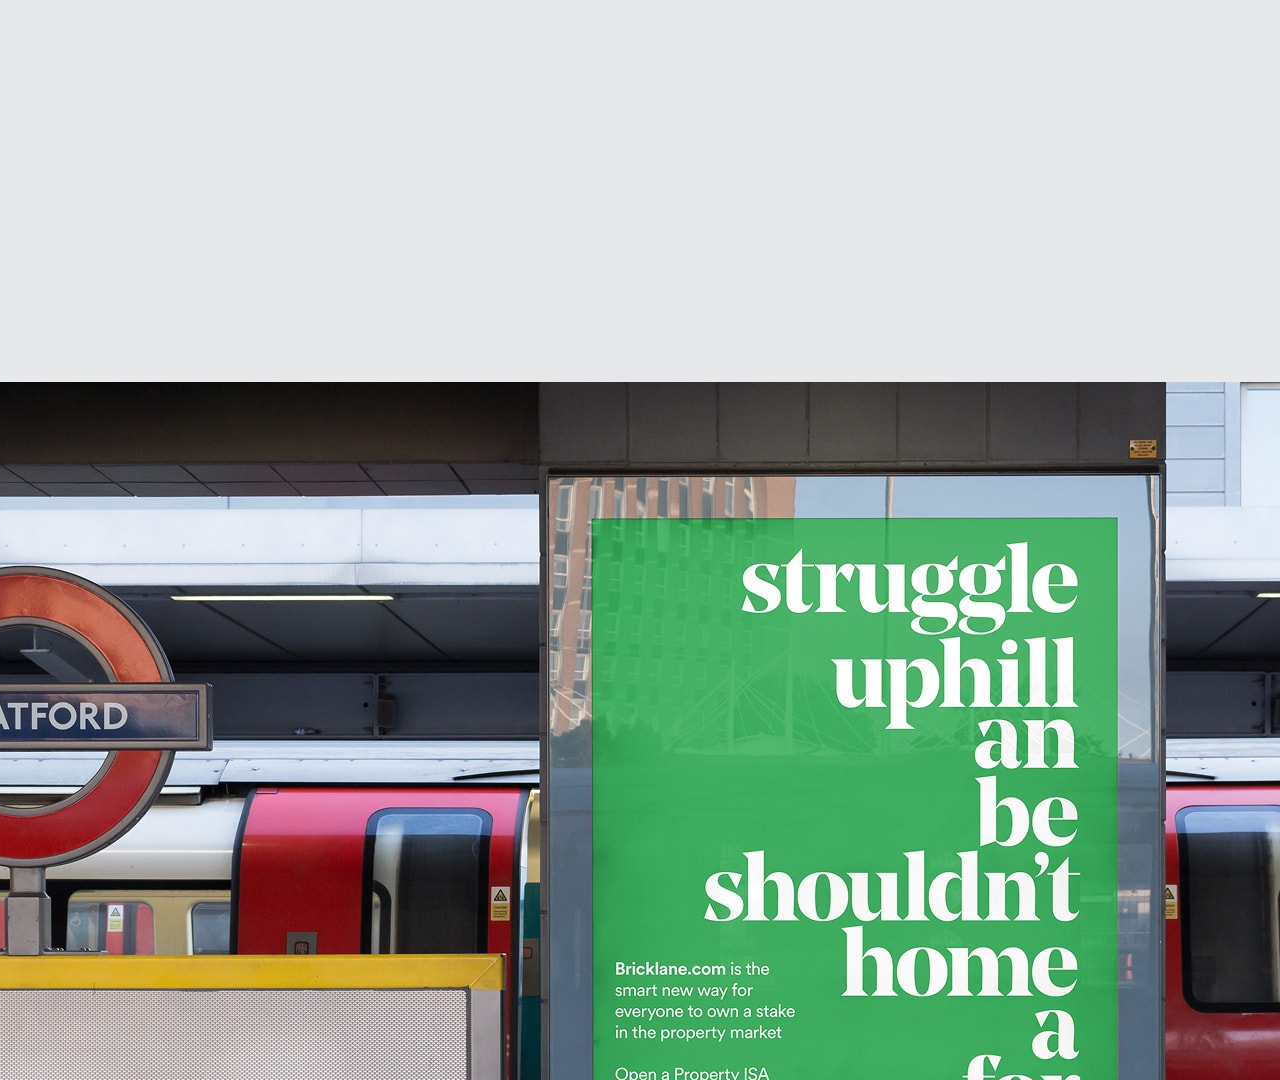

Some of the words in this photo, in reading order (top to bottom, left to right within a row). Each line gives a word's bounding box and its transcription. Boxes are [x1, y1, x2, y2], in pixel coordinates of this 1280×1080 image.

[742, 542, 1077, 635] struggle
[832, 637, 1078, 729] uphill
[975, 720, 1079, 769] an
[976, 776, 1077, 846] be
[704, 851, 1080, 921] shouldn't
[615, 961, 726, 976] Bricklane.com
[730, 961, 742, 976] is
[746, 961, 770, 976] the
[842, 926, 1077, 996] home
[615, 984, 658, 997] smart
[663, 986, 694, 997] new
[697, 986, 729, 1001] way
[732, 983, 754, 997] for
[615, 1006, 684, 1021] everyone
[687, 1005, 703, 1018] to
[707, 1007, 739, 1018] own
[743, 1007, 752, 1018] a
[756, 1003, 796, 1018] stake
[615, 1025, 628, 1039] in
[631, 1024, 657, 1039] the
[661, 1026, 727, 1043] property
[730, 1024, 782, 1039] market
[1032, 1010, 1079, 1059] a
